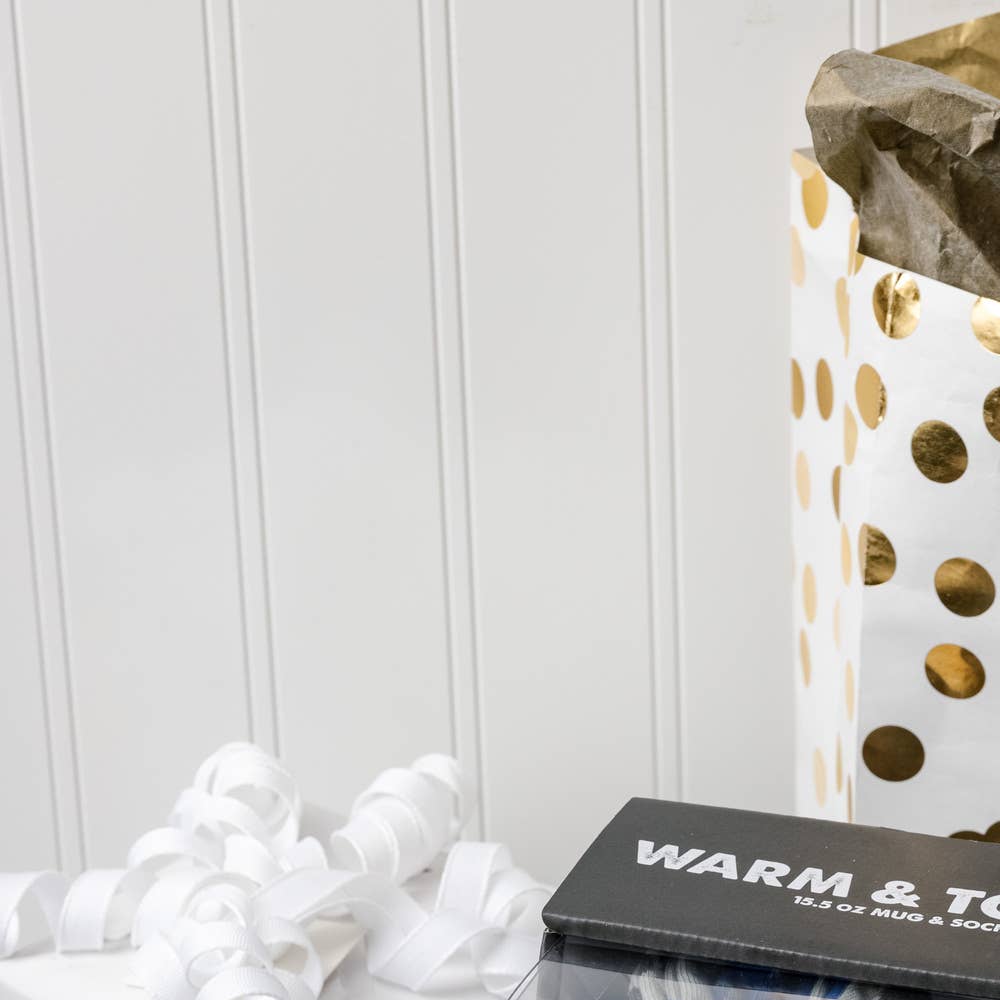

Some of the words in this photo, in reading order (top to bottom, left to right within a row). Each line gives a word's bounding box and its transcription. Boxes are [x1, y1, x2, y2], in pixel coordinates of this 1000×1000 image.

[637, 839, 853, 898] WARM
[871, 880, 920, 908] &
[792, 895, 832, 910] 15.5
[836, 903, 865, 915] OZ
[870, 908, 924, 923] MUG
[929, 916, 944, 926] &
